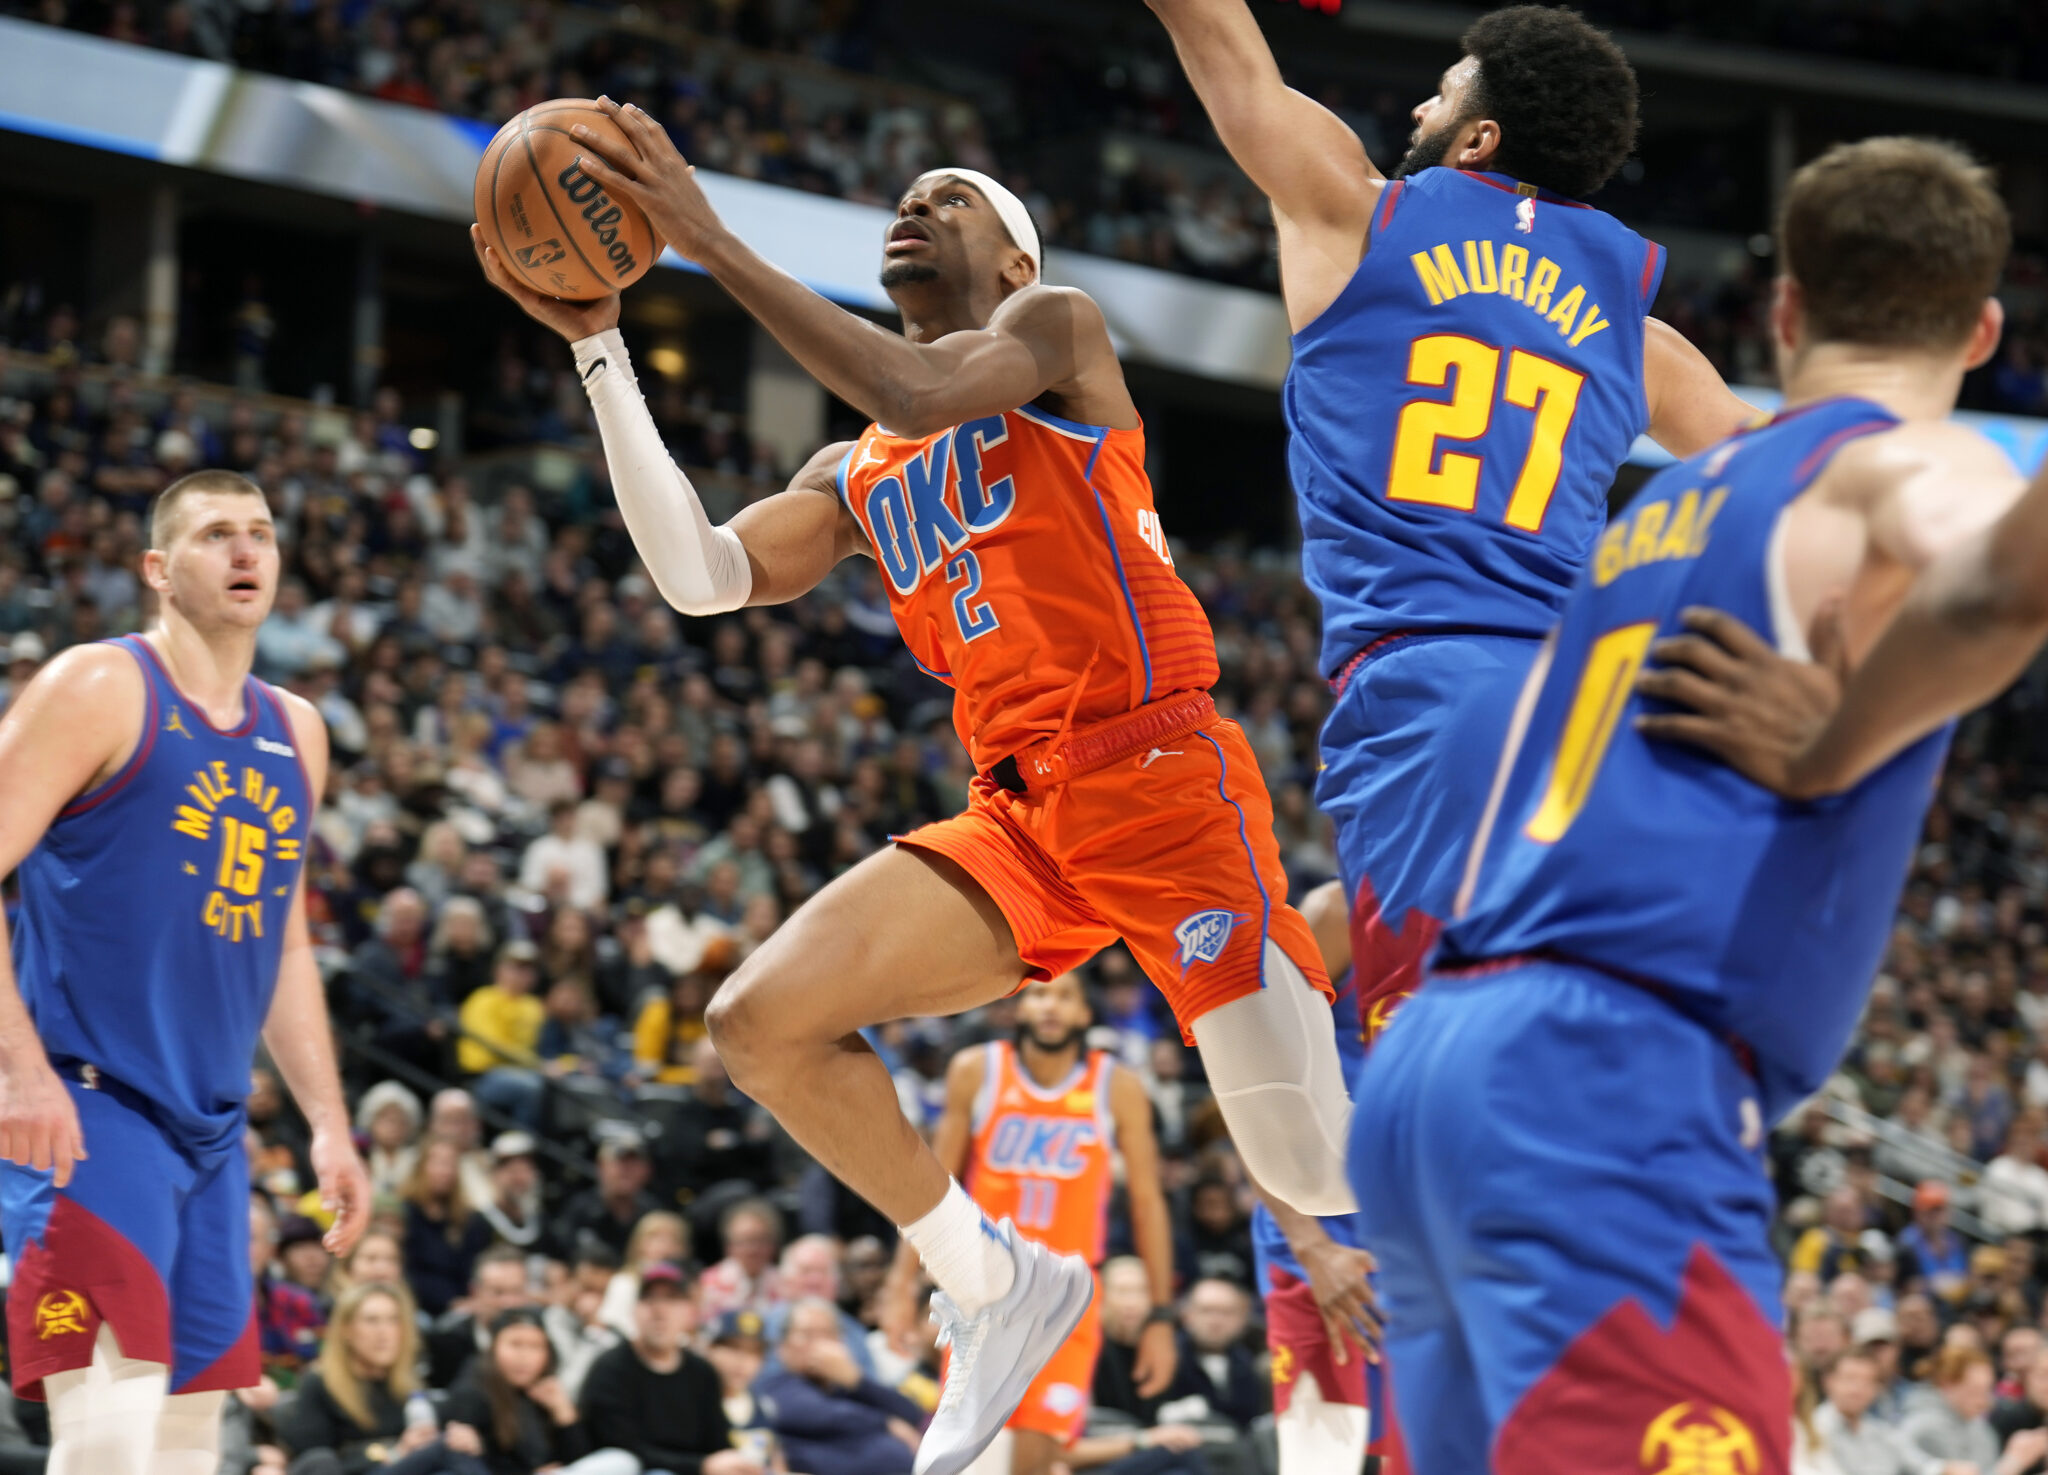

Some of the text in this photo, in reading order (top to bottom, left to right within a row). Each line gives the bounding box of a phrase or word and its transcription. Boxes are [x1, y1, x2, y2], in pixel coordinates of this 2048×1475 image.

[558, 155, 637, 278] Wilson
[1410, 240, 1610, 348] MURRAY
[1385, 332, 1589, 534] 27
[866, 414, 1016, 595] OKC
[946, 548, 1000, 644] 2
[1524, 619, 1658, 843] 0
[171, 760, 301, 860] MILE HIGH
[216, 815, 267, 896] 15
[203, 891, 264, 943] CITY
[1182, 917, 1220, 963] OKC
[986, 1112, 1098, 1179] OKC
[1017, 1177, 1057, 1229] 11
